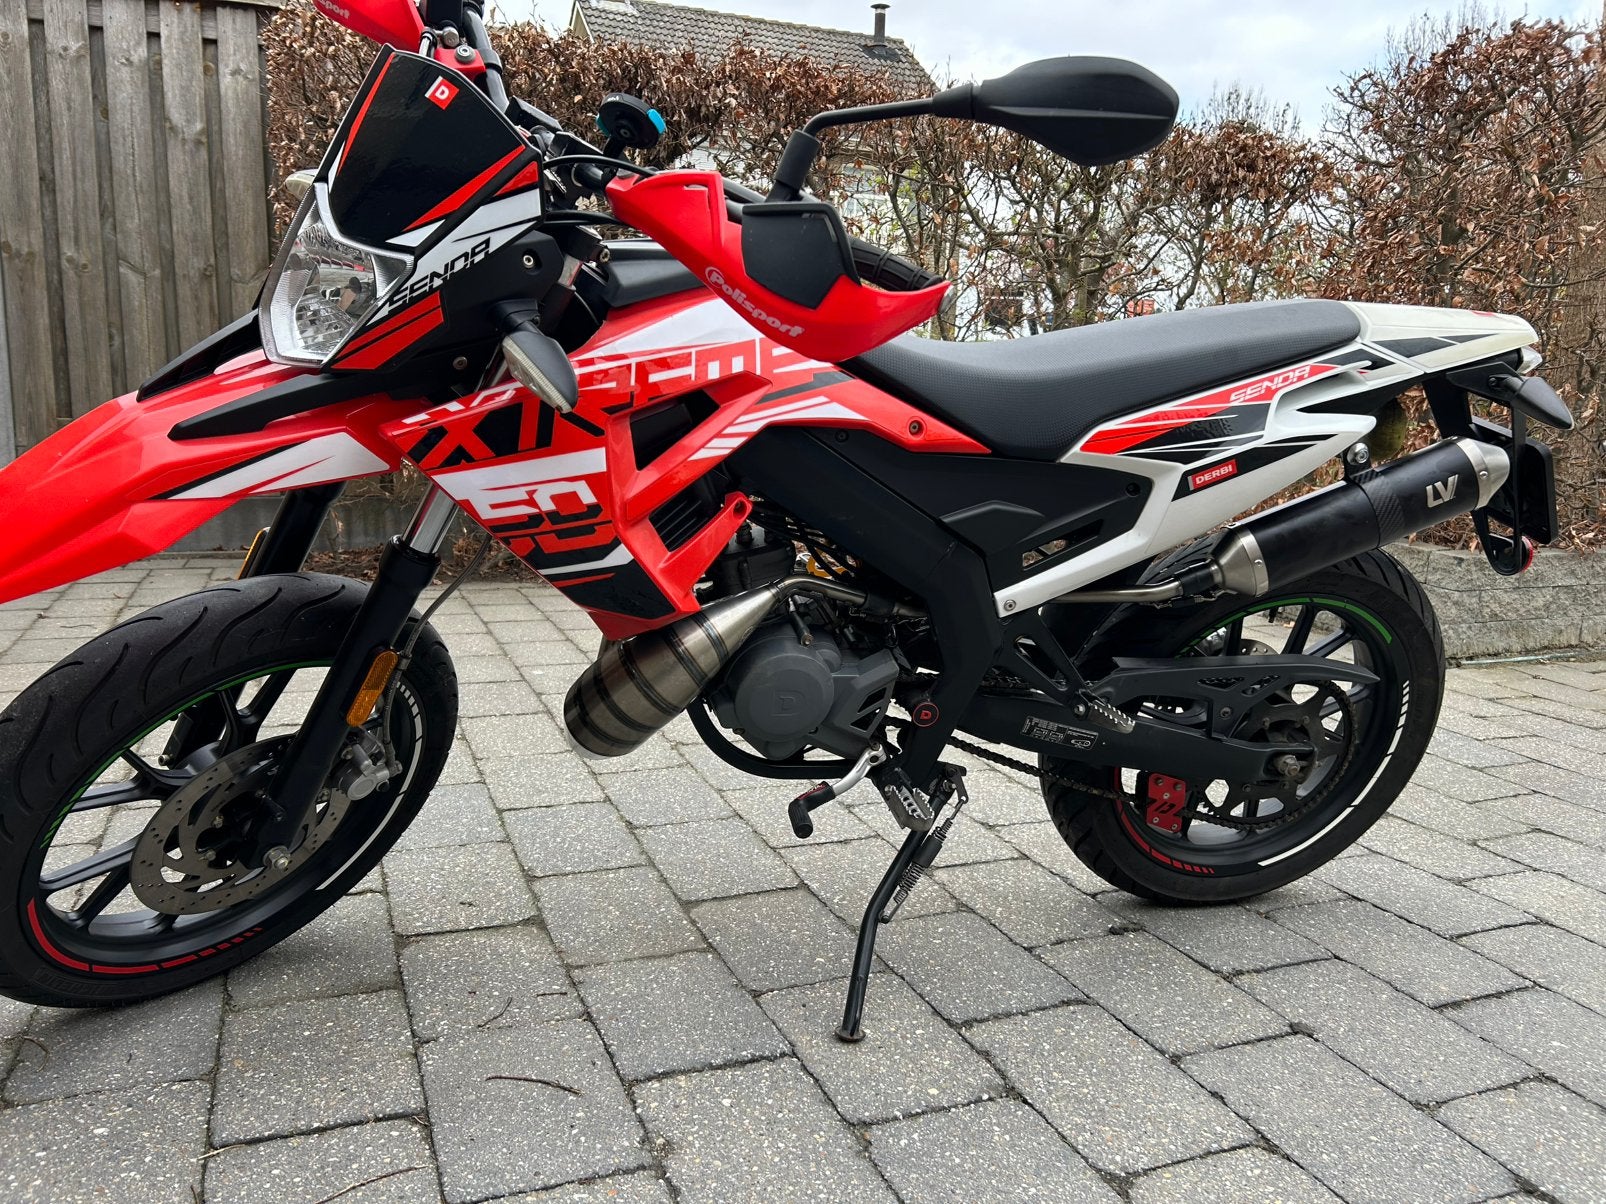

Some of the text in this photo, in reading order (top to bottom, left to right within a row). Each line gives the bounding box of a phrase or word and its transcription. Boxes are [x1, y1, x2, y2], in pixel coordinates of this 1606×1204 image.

[435, 85, 450, 100] D
[386, 236, 491, 314] SENDA
[706, 268, 805, 337] Polisport
[1230, 365, 1311, 405] SENDA
[1195, 464, 1233, 485] DERBI
[1425, 474, 1459, 508] LV
